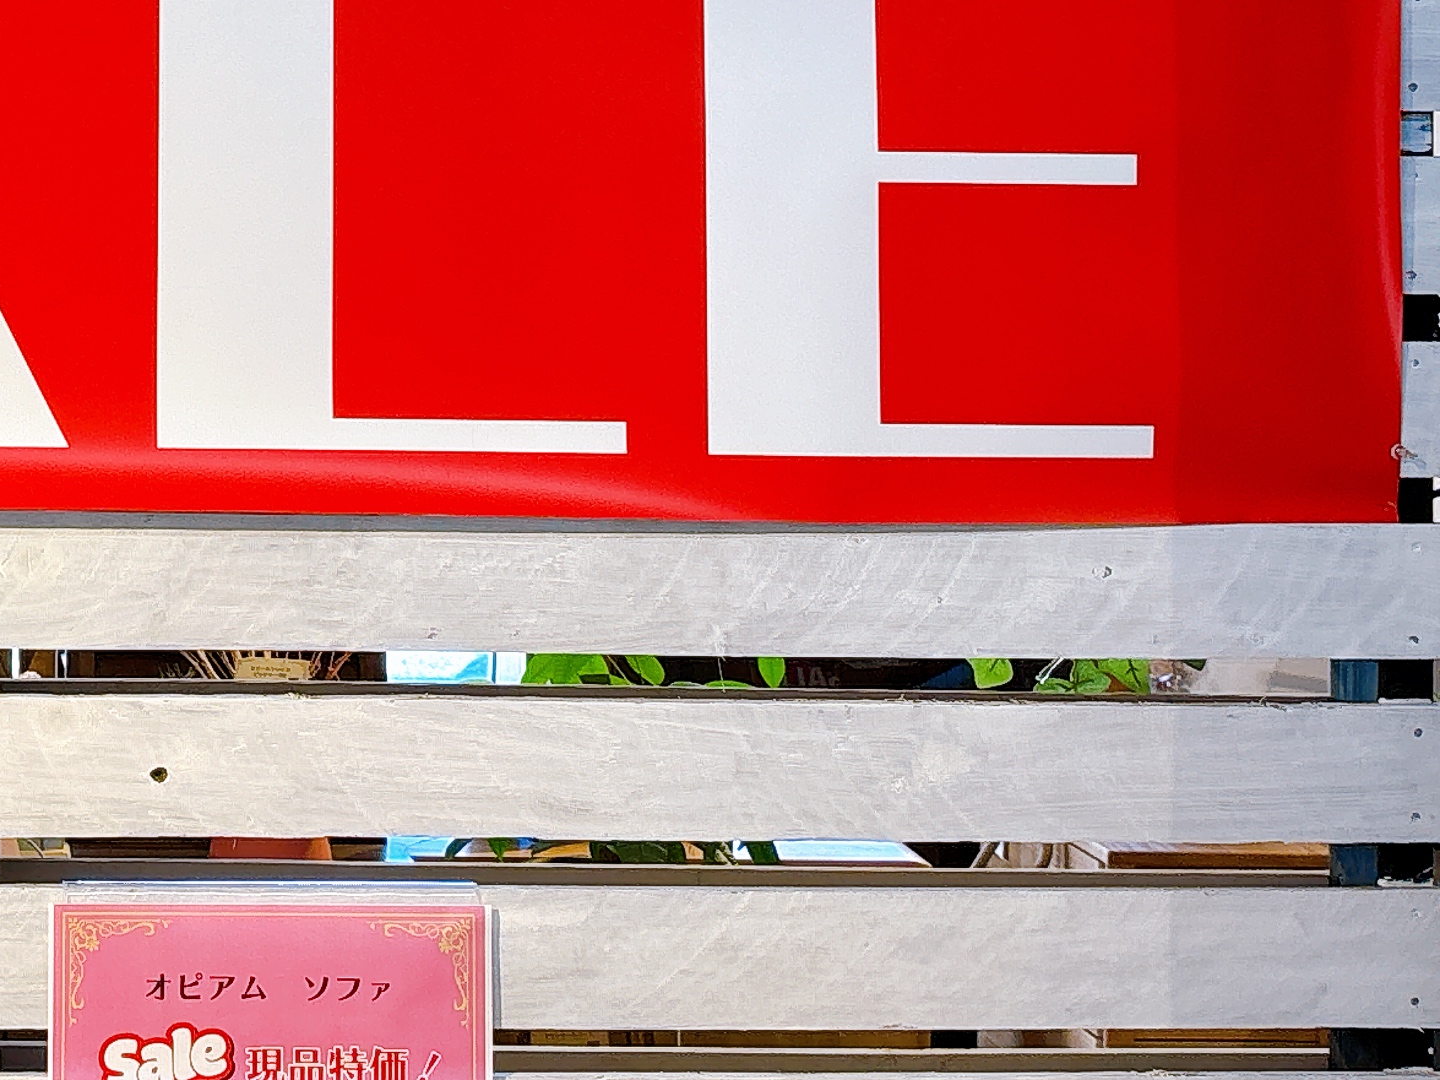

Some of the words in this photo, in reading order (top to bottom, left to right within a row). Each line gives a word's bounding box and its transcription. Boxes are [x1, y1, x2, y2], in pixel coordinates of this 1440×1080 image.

[145, 971, 267, 1002] オピアム
[304, 972, 391, 1002] ソファ
